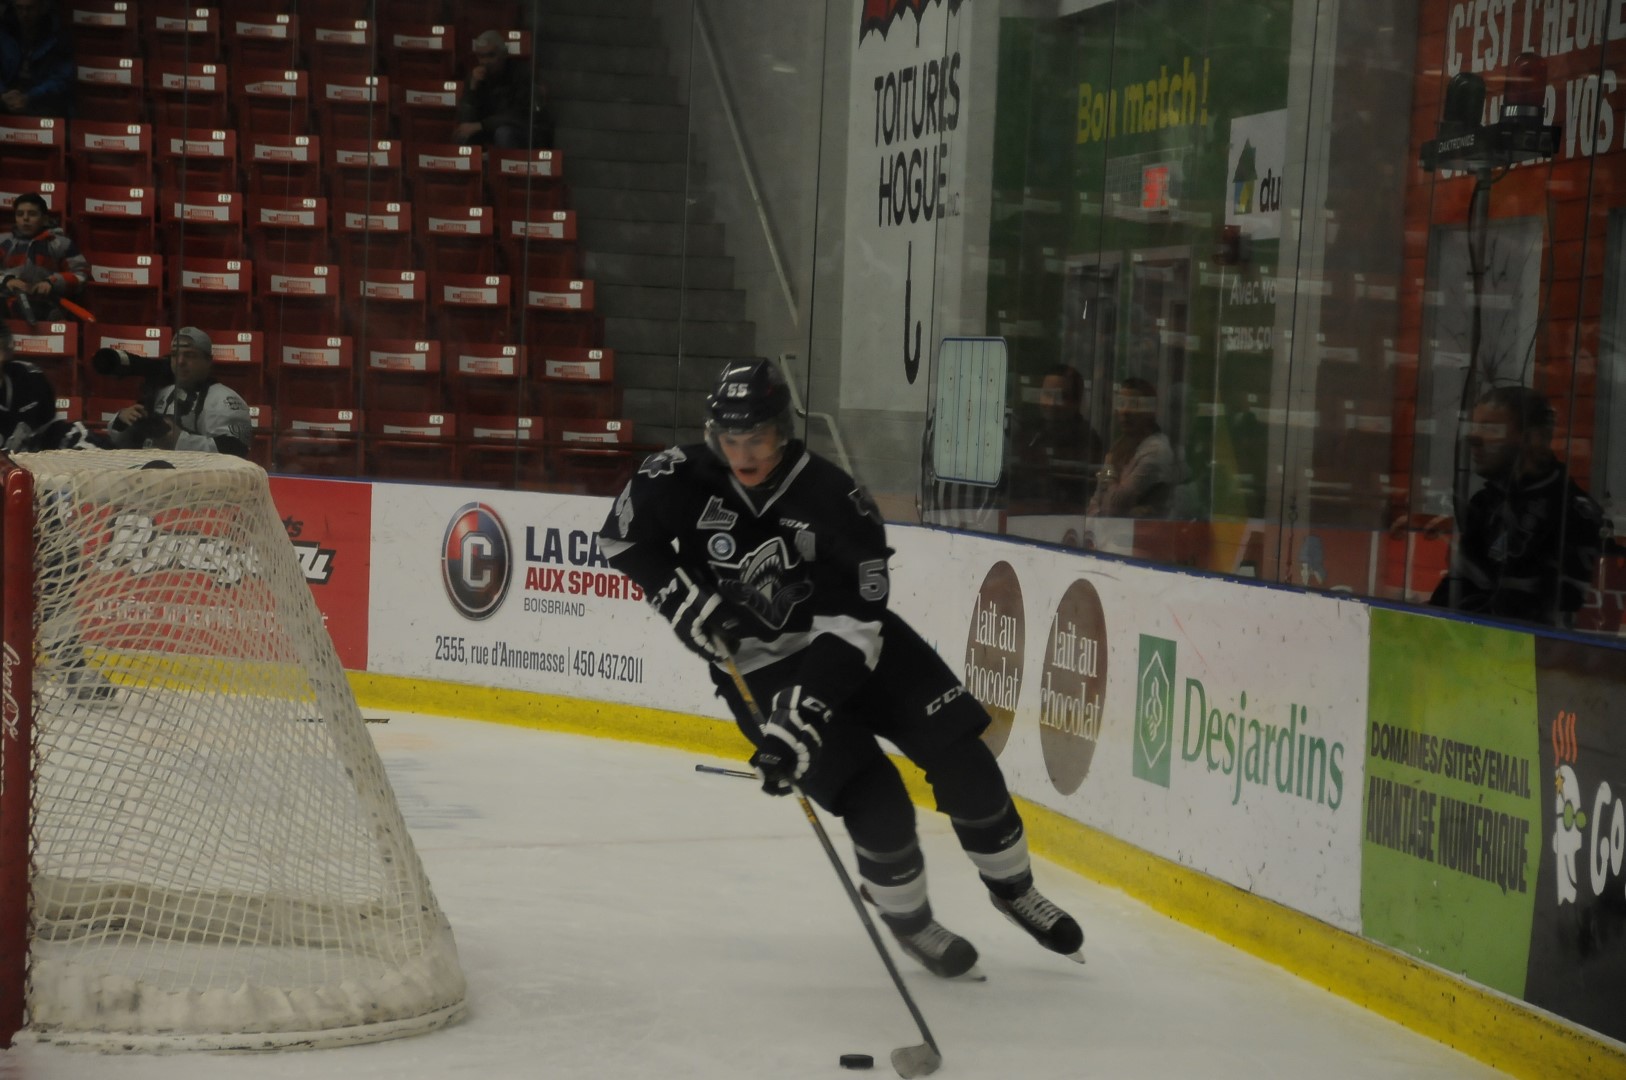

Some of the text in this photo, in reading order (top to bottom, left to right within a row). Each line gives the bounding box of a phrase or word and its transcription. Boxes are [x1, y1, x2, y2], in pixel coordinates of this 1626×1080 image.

[1447, 0, 1514, 77] C'EST
[874, 52, 960, 147] TOITURES
[1076, 82, 1118, 144] Bon
[1565, 69, 1617, 159] VOS
[879, 143, 947, 227] HOGUE
[727, 383, 750, 398] 55
[525, 526, 564, 565] LA
[524, 597, 586, 618] BOISBRIAND
[525, 566, 644, 602] AUX SPORTS
[858, 559, 890, 601] 5
[975, 592, 1018, 654] lait au
[1052, 611, 1099, 679] lait au
[435, 634, 644, 685] 2555, rue d'Annemasse 450 437.2011
[965, 647, 1020, 713] chocolat
[1039, 671, 1101, 744] chocolat
[1181, 677, 1346, 812] Desjardins
[1370, 720, 1532, 801] DOMAINES/SITES/EMAIL
[1366, 774, 1530, 897] AVANTAGE NUMÉRIQUE
